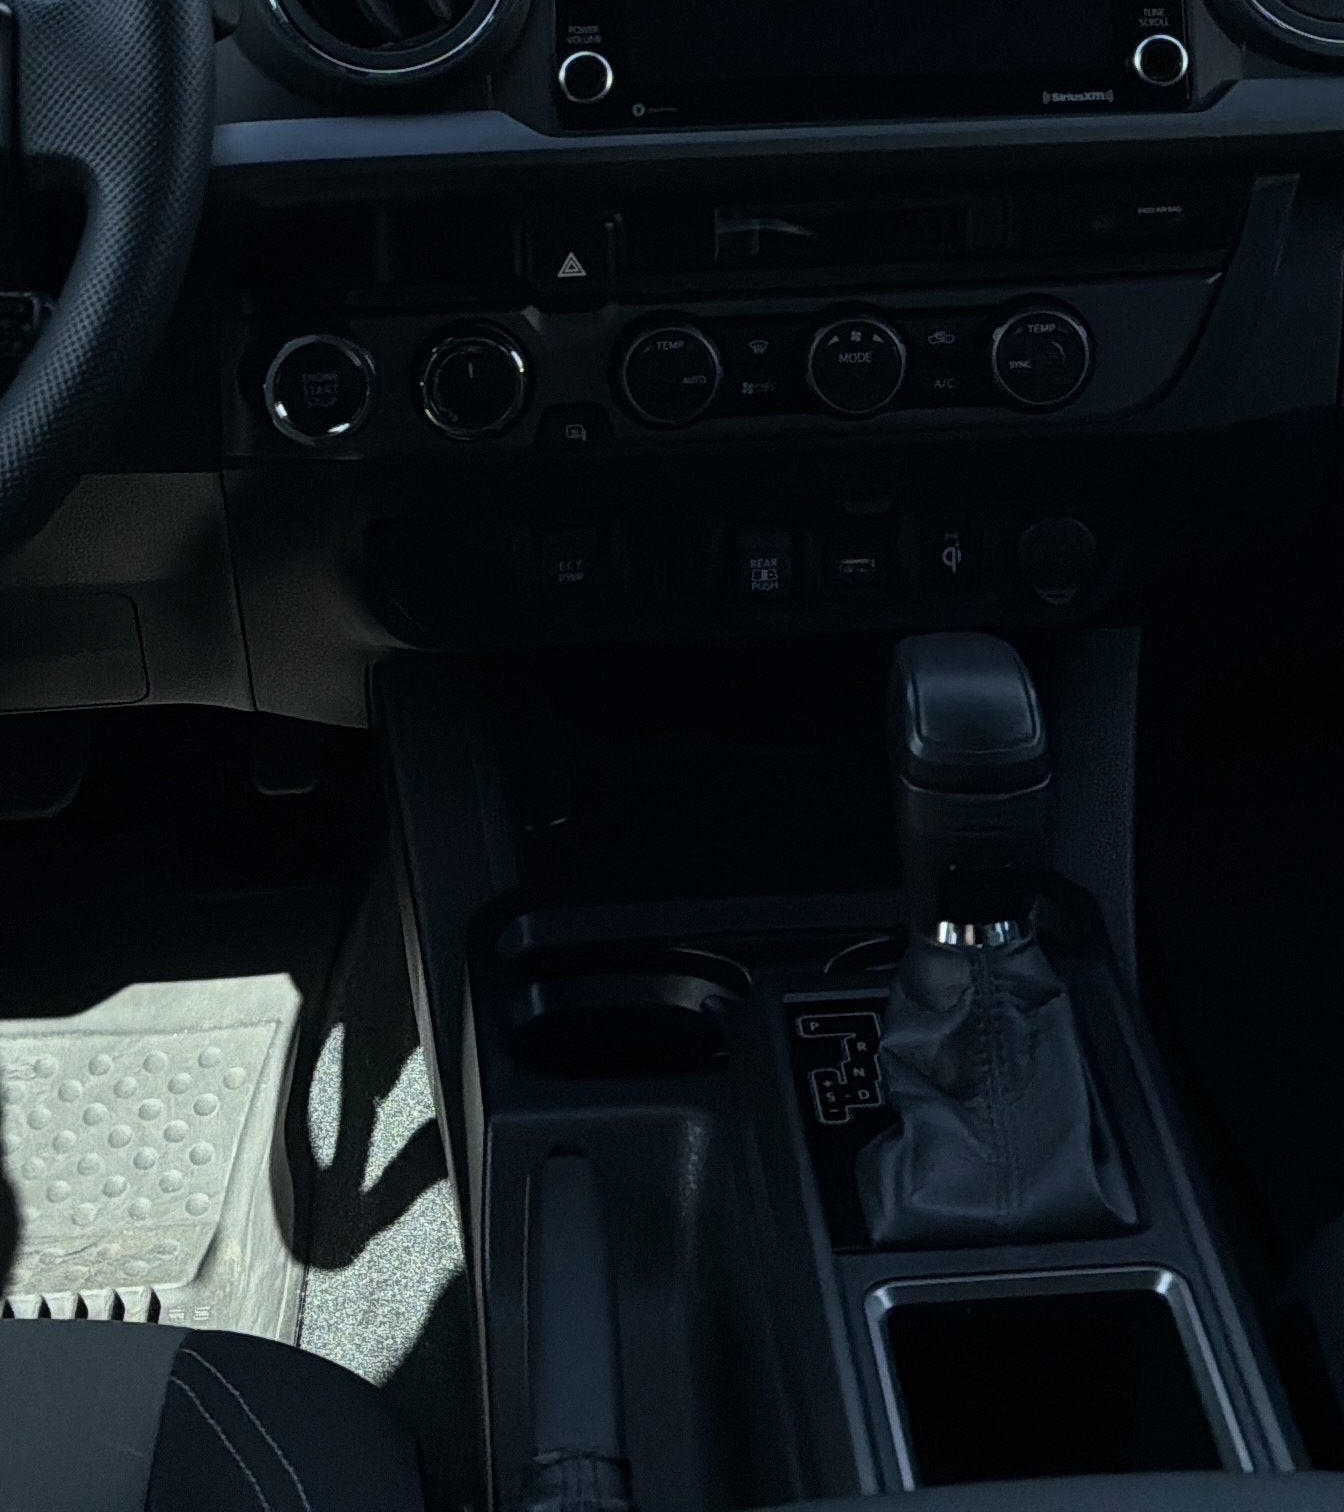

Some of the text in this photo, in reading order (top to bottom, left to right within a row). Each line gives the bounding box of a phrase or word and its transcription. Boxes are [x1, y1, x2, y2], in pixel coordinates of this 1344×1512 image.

[1027, 322, 1057, 335] TEMP
[655, 338, 686, 352] TEMP
[837, 350, 874, 365] MODE
[933, 377, 957, 390] A/C
[808, 1020, 821, 1033] P
[856, 1040, 868, 1052] R
[852, 1067, 866, 1078] N
[825, 1091, 837, 1104] S
[857, 1089, 871, 1101] D
